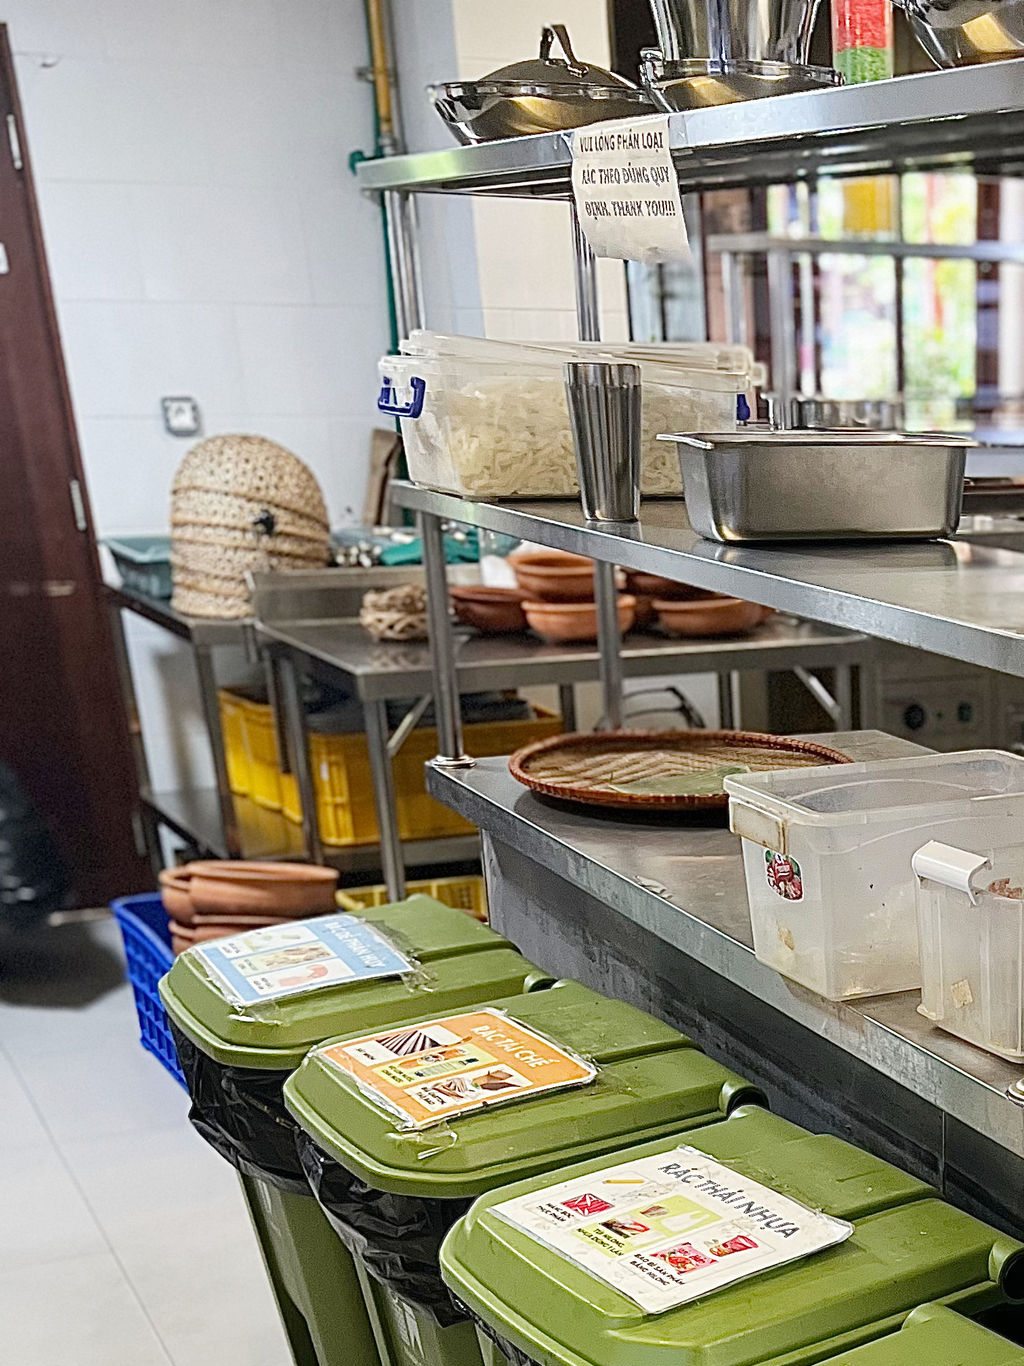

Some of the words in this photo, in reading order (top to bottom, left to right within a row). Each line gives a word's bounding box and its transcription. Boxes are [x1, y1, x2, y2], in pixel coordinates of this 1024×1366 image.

[580, 136, 593, 152] VUI
[642, 131, 664, 153] LOẠI
[651, 166, 670, 187] QUY
[611, 200, 644, 217] THANK
[645, 199, 676, 217] YOU!!!
[658, 1162, 704, 1184] RÁC
[694, 1179, 746, 1204] THẢI
[734, 1200, 800, 1238] NHỰA
